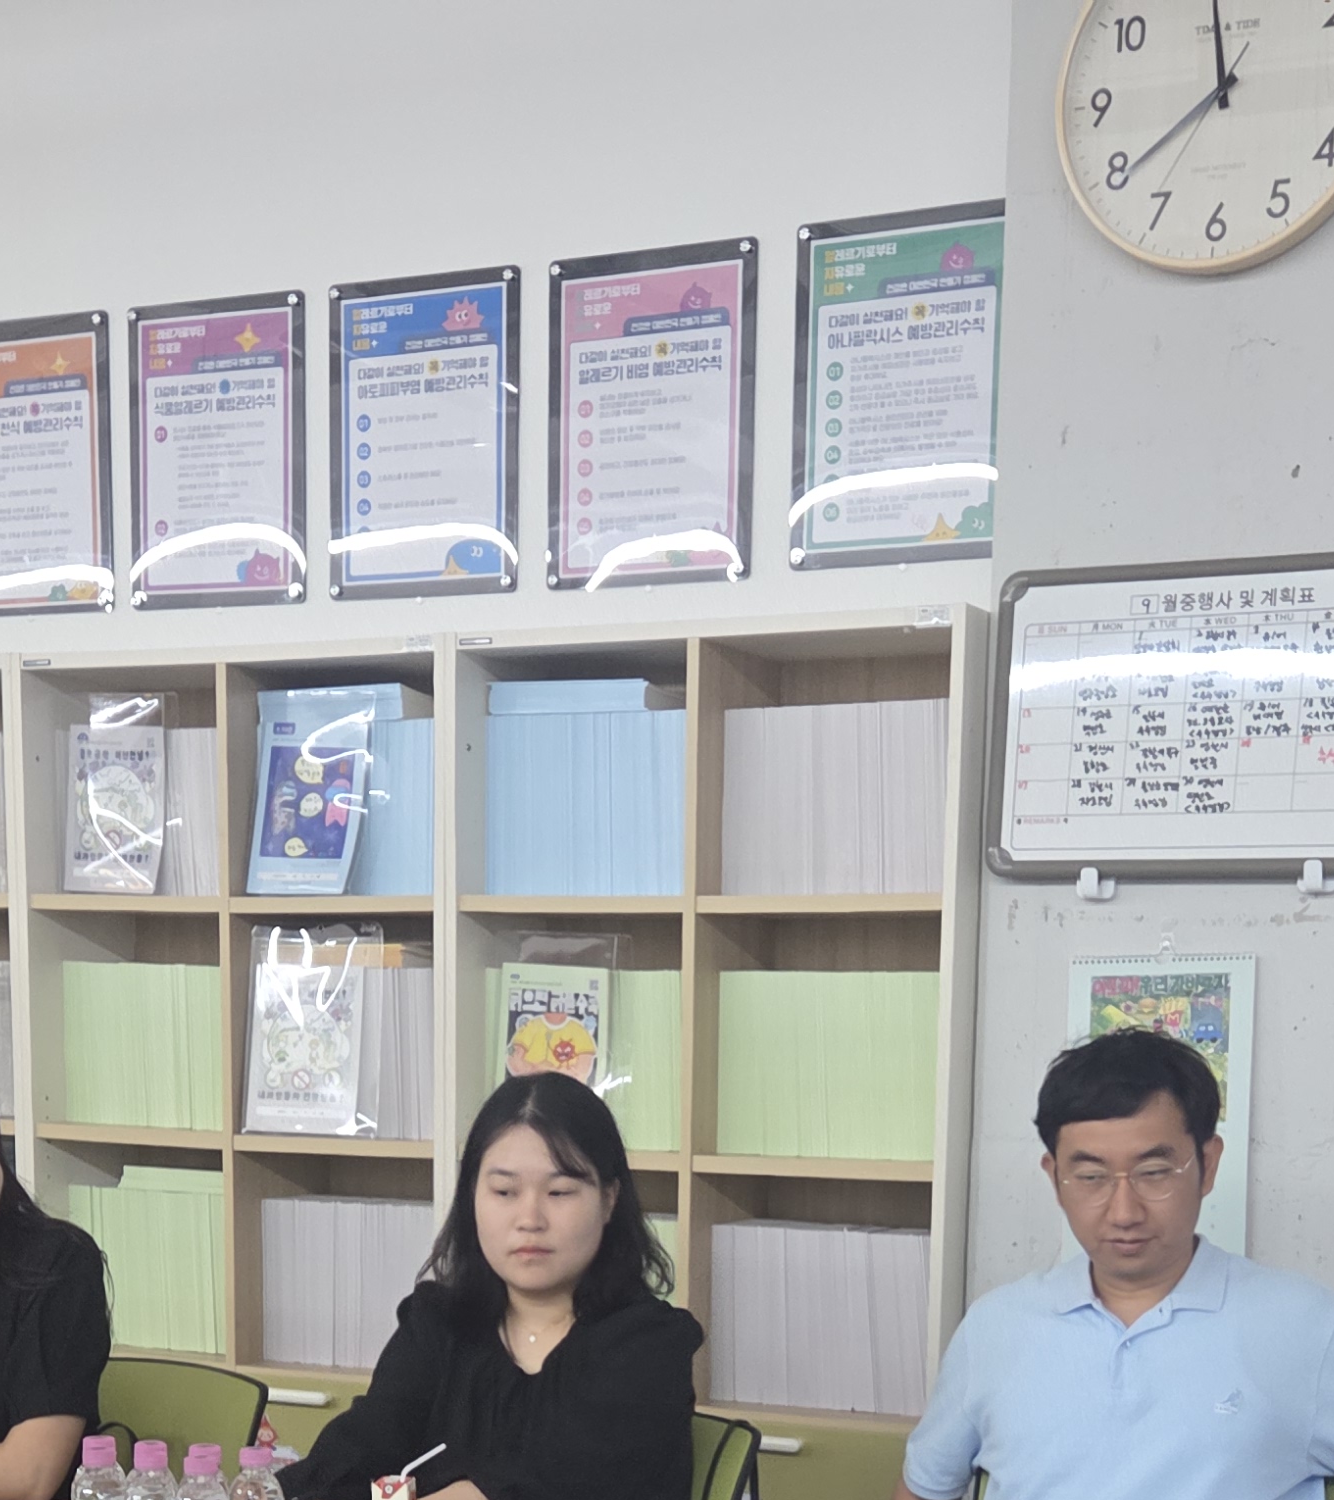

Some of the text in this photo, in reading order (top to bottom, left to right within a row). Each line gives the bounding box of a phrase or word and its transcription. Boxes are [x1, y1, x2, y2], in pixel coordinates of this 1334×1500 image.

[1113, 15, 1146, 53] 10
[1090, 88, 1113, 128] 9
[1105, 151, 1129, 190] 8
[1266, 178, 1291, 218] 5
[1150, 191, 1173, 231] 7
[1205, 201, 1227, 242] 6
[824, 242, 897, 263] 알레르기로부터
[824, 263, 866, 280] 자유로운
[827, 317, 986, 350] 아나필락시스 예방관리수칙
[578, 355, 722, 386] 알레르기 비염 예방관리수칙
[357, 372, 489, 400] 아토피피부염 예방관리수칙
[216, 393, 276, 412] 예방관리수칙
[0, 415, 83, 436] 천식 예방관리수칙
[1141, 586, 1316, 615] 9 월중행사 및 계획표
[1047, 625, 1068, 634] SUN
[1102, 622, 1124, 631] MON
[1159, 619, 1178, 628] TUE
[1214, 616, 1237, 625] WED
[1274, 613, 1295, 622] THU
[1182, 775, 1194, 786] 30
